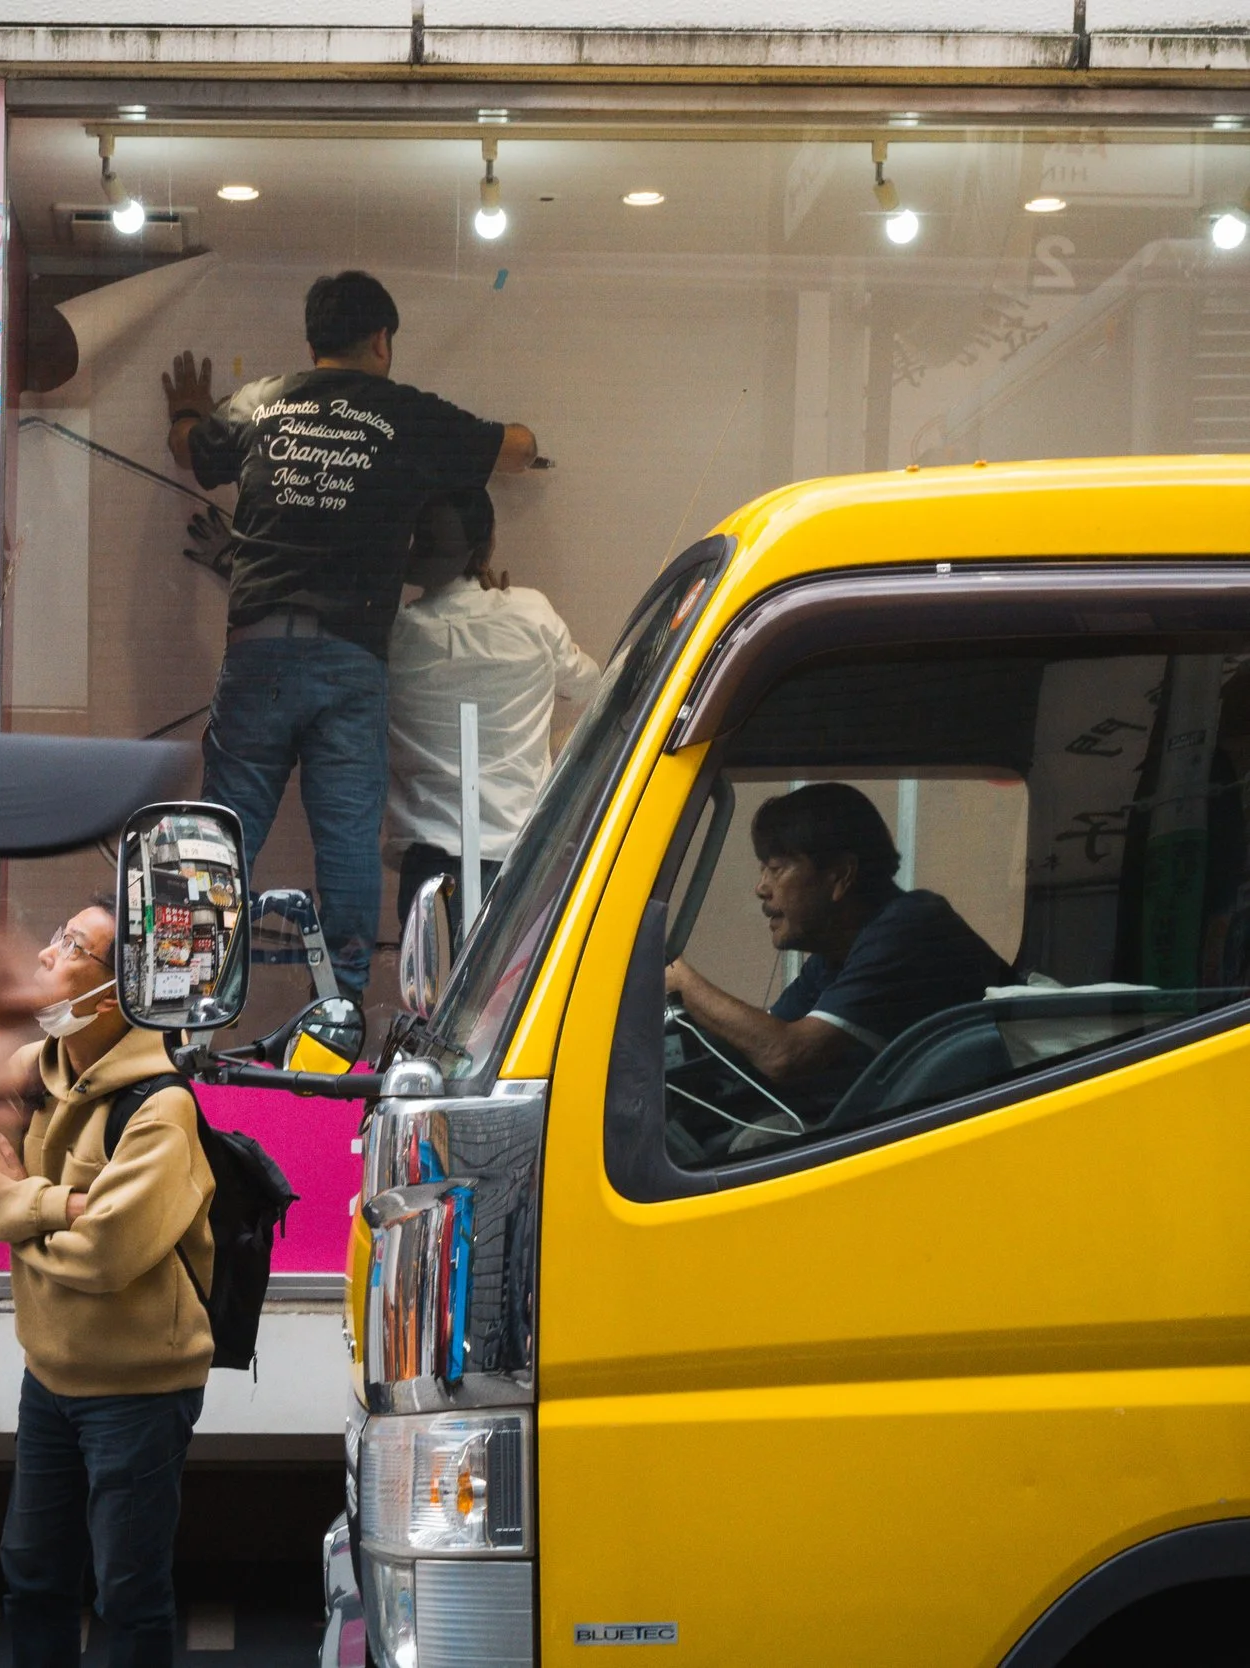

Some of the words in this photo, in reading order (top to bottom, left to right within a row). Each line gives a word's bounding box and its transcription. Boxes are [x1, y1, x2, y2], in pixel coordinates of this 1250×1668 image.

[252, 398, 321, 428] Authentic
[330, 399, 397, 441] American
[278, 416, 367, 442] Athleticwear
[271, 467, 311, 486] New
[313, 471, 356, 493] York
[275, 487, 316, 507] Since
[319, 496, 348, 511] 1919
[576, 1625, 676, 1642] BLUETEC
